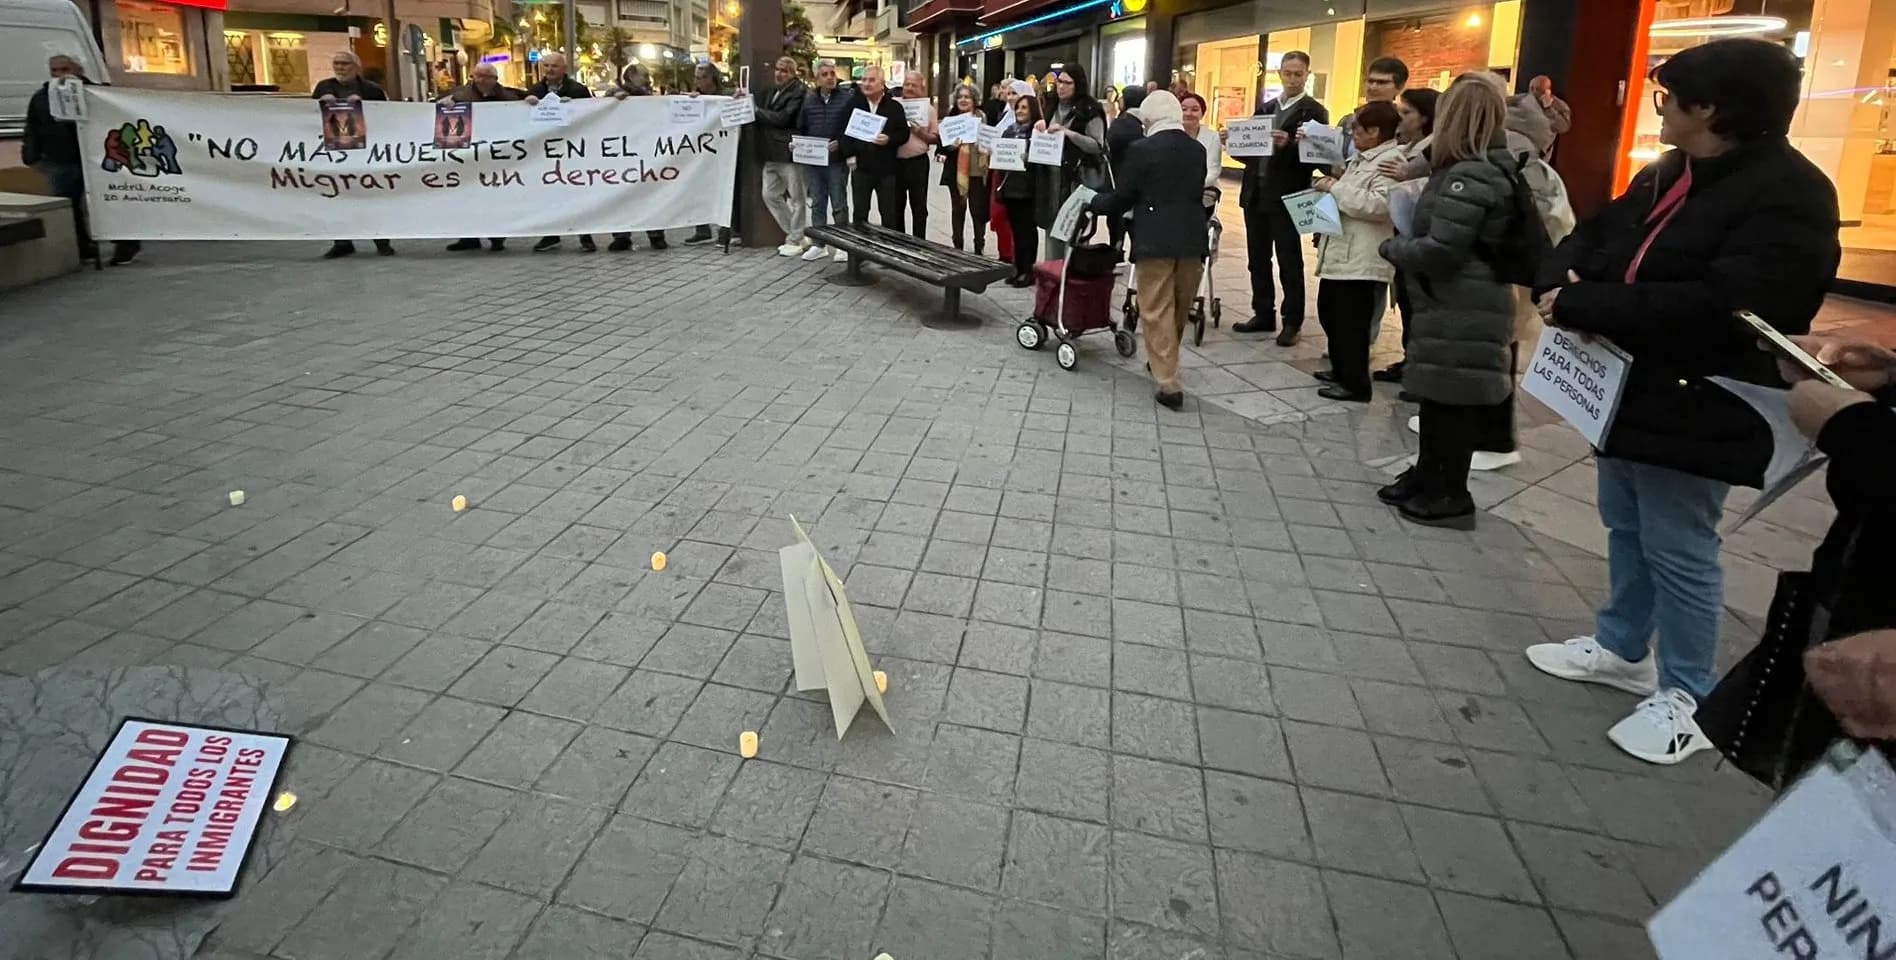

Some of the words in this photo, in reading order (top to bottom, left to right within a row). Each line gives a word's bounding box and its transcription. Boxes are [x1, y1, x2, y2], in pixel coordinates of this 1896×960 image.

[543, 137, 585, 159] EN
[601, 135, 638, 158] EL
[270, 166, 402, 198] Migrar
[421, 171, 460, 188] es
[479, 168, 525, 188] un
[541, 159, 680, 188] derecho
[1542, 347, 1571, 375] PARA
[1573, 366, 1605, 401] TODAS
[1553, 332, 1607, 379] DERECHOS
[1533, 362, 1554, 381] LAS
[1552, 376, 1601, 421] PERSONAS
[51, 728, 190, 880] DIGNIDAD
[134, 830, 190, 882] PARA
[163, 768, 217, 825] TODOS
[194, 735, 233, 764] LOS
[186, 747, 265, 873] INMIGRANTES
